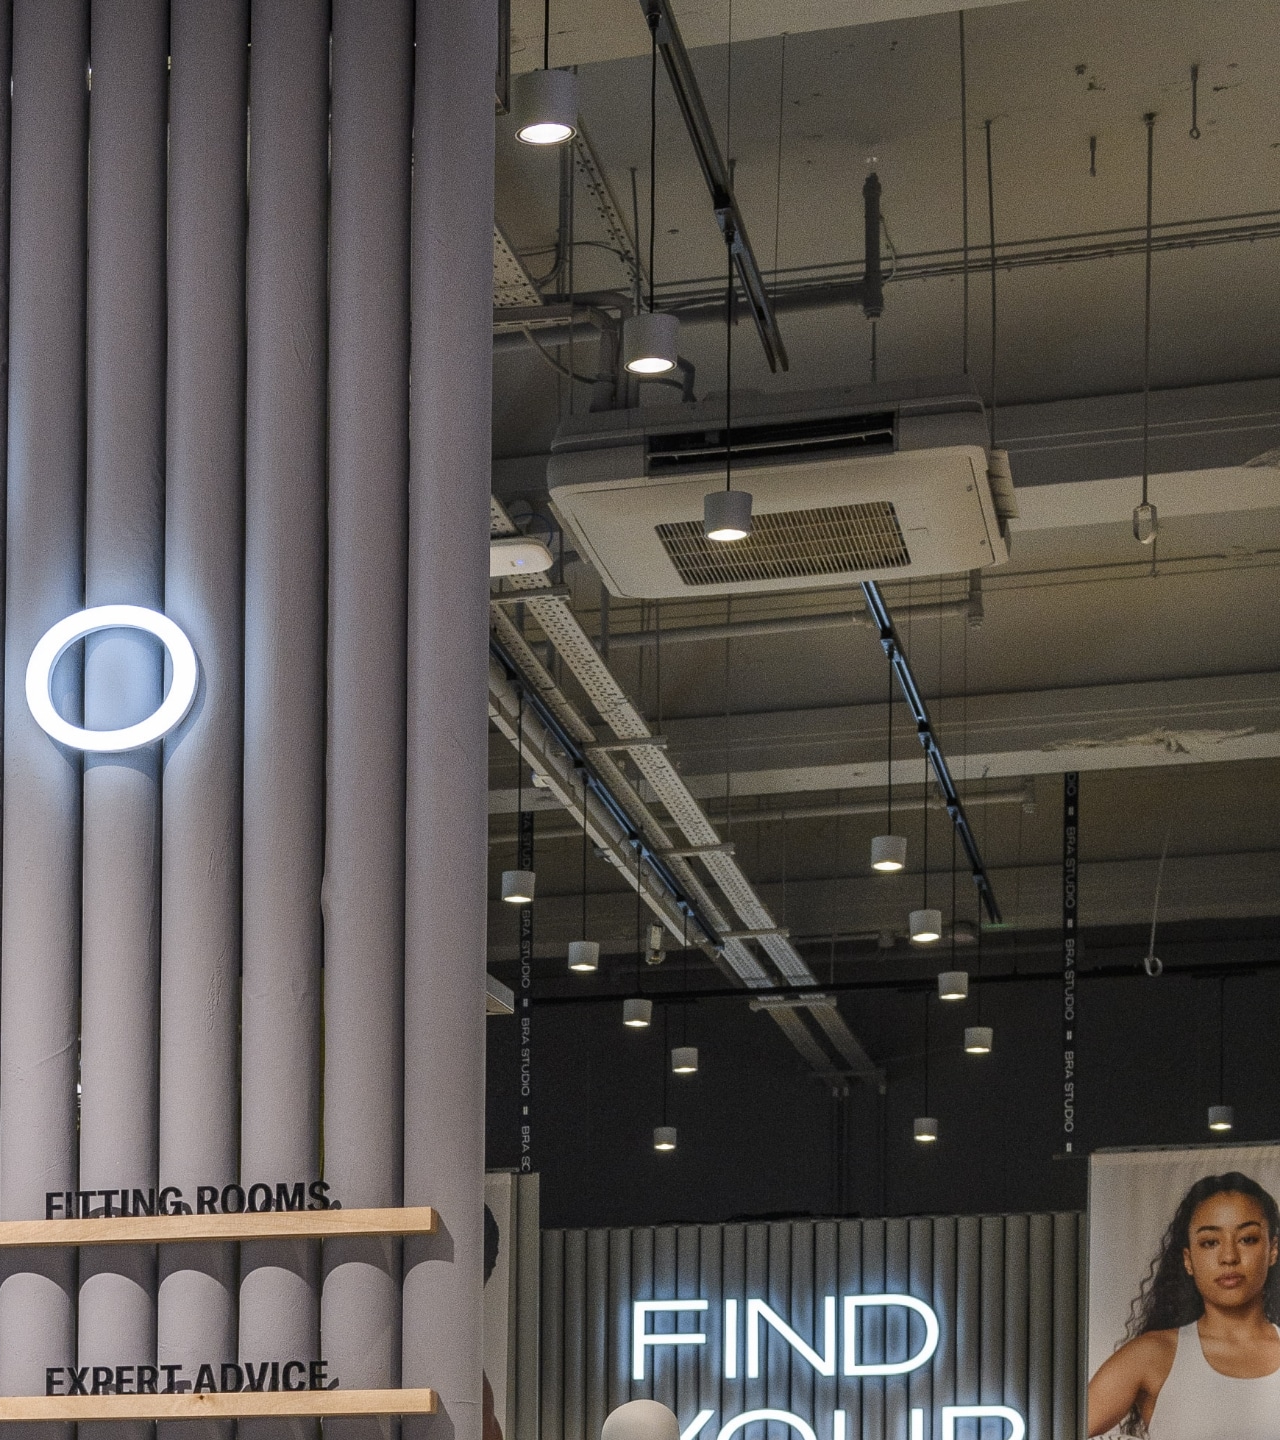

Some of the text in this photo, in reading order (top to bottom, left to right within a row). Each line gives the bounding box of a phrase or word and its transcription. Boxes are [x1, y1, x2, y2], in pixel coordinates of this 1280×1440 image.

[1065, 826, 1076, 854] BRA
[1065, 858, 1076, 908] STUDIO
[522, 910, 531, 937] BRA
[521, 940, 531, 989] STUDIO
[1065, 939, 1075, 967] BRA
[1064, 970, 1075, 1020] STUDIO
[521, 1017, 531, 1045] BRA
[521, 1048, 531, 1096] STUDIO
[1064, 1050, 1075, 1078] BRA
[1064, 1082, 1074, 1133] STUDIO
[521, 1125, 531, 1153] BRA
[45, 1181, 331, 1220] FITTING ROOMS
[632, 1293, 940, 1381] FIND
[45, 1360, 329, 1396] EXPERT ADVICE
